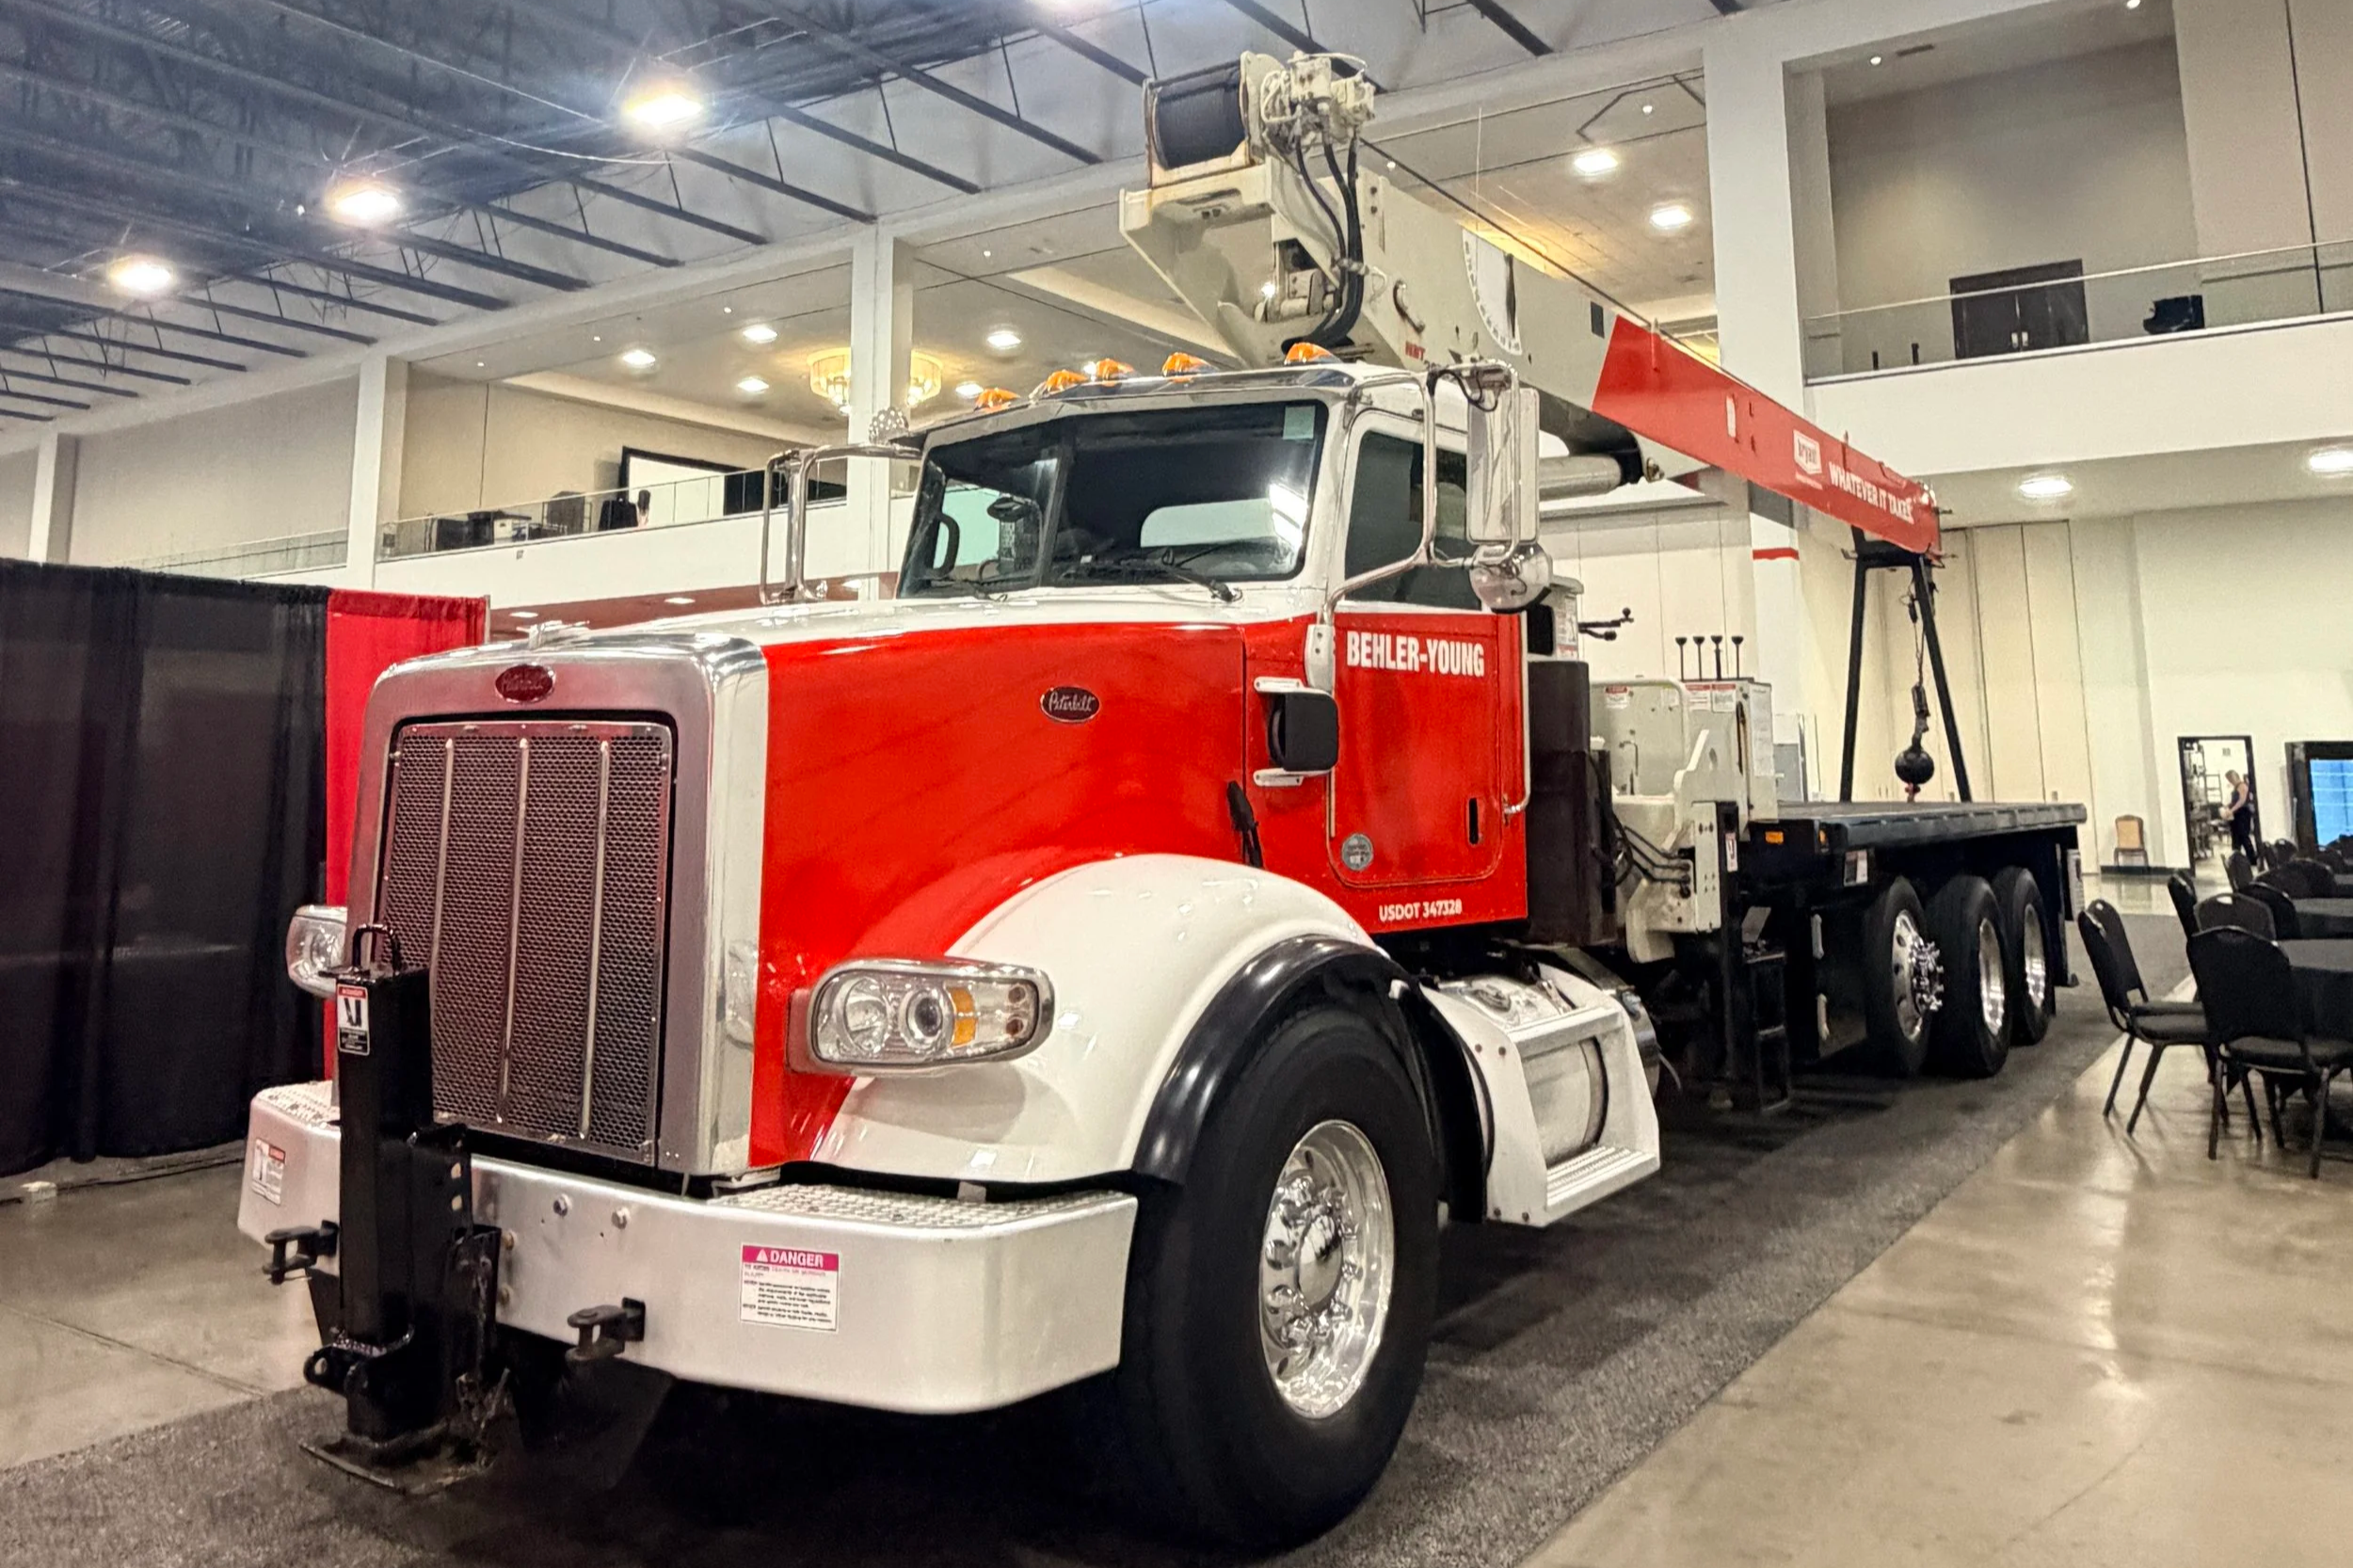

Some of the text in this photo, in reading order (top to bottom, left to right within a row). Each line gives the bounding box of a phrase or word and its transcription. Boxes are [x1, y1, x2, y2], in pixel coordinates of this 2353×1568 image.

[1829, 461, 1879, 507] WHATEVER
[1878, 487, 1887, 513] IT
[1888, 492, 1915, 525] TAKES
[1347, 631, 1484, 677] BEHLER-YOUNG
[1379, 902, 1421, 922] USDOT
[770, 1249, 824, 1269] DANGER
